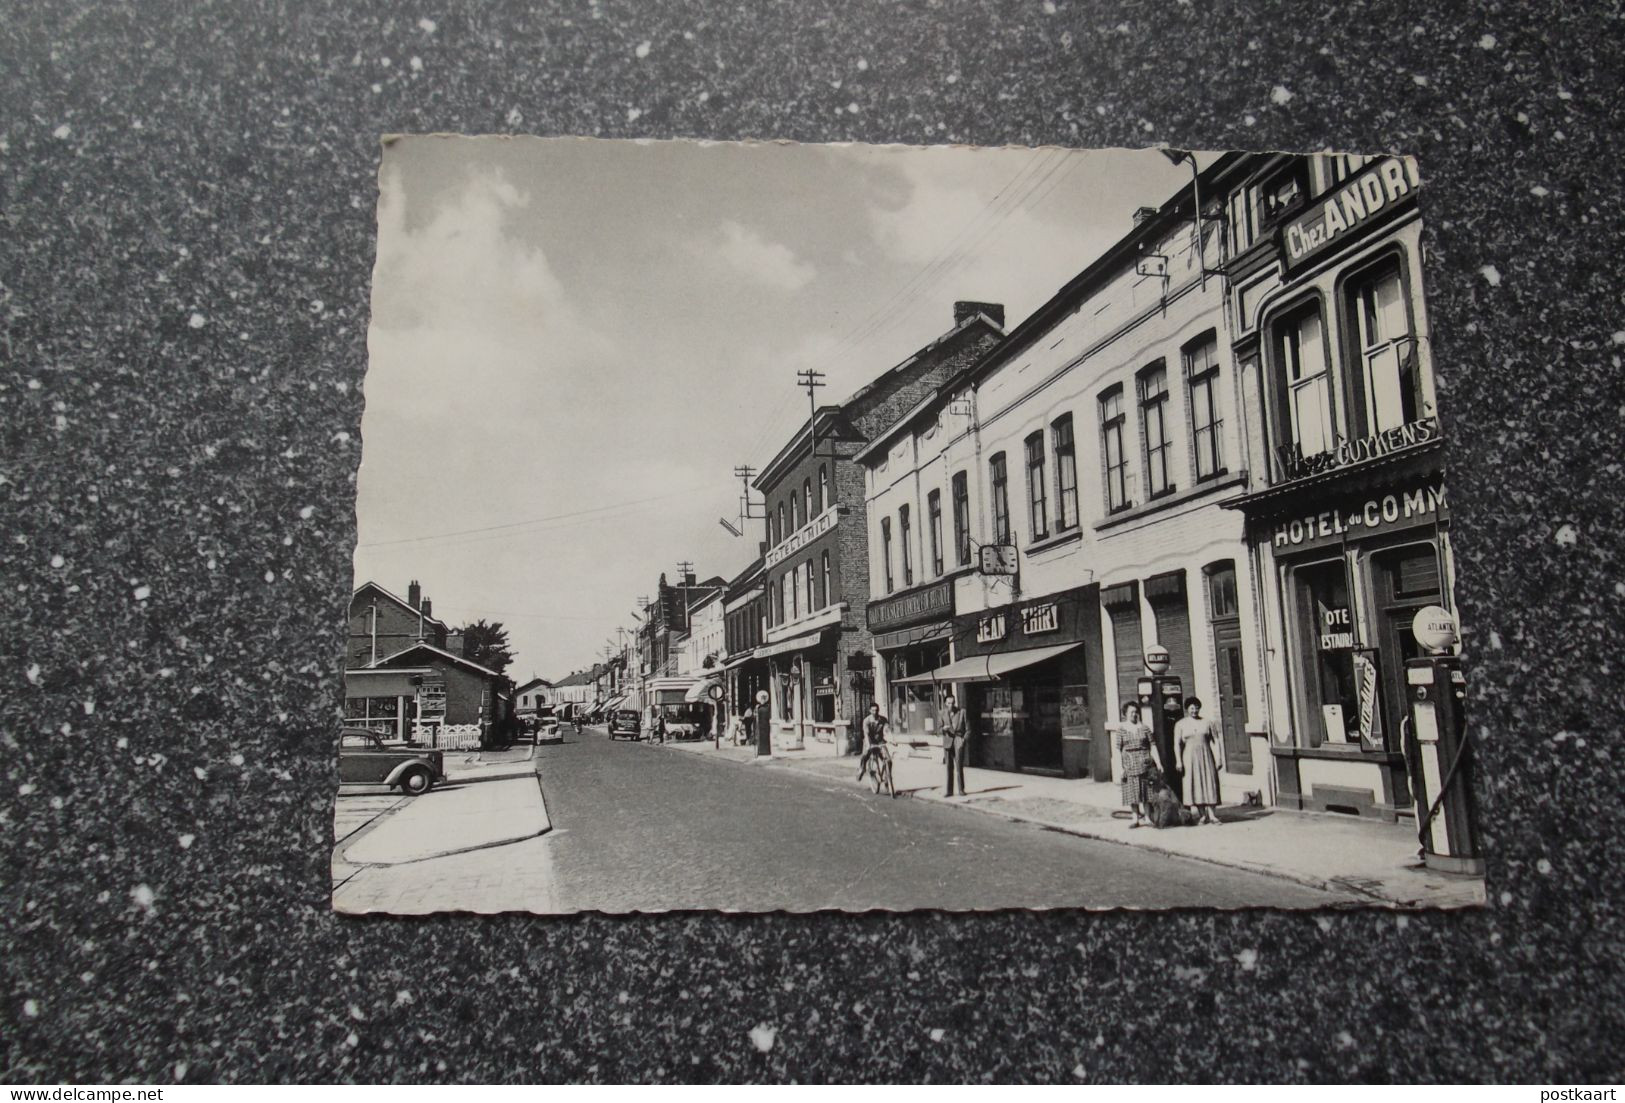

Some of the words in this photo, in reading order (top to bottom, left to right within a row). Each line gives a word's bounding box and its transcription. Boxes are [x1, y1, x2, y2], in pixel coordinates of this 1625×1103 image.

[1287, 222, 1326, 259] Chez
[1274, 508, 1348, 547] HOTEL
[1349, 512, 1361, 526] du
[977, 614, 1006, 643] JEAN
[1326, 608, 1350, 626] OTE
